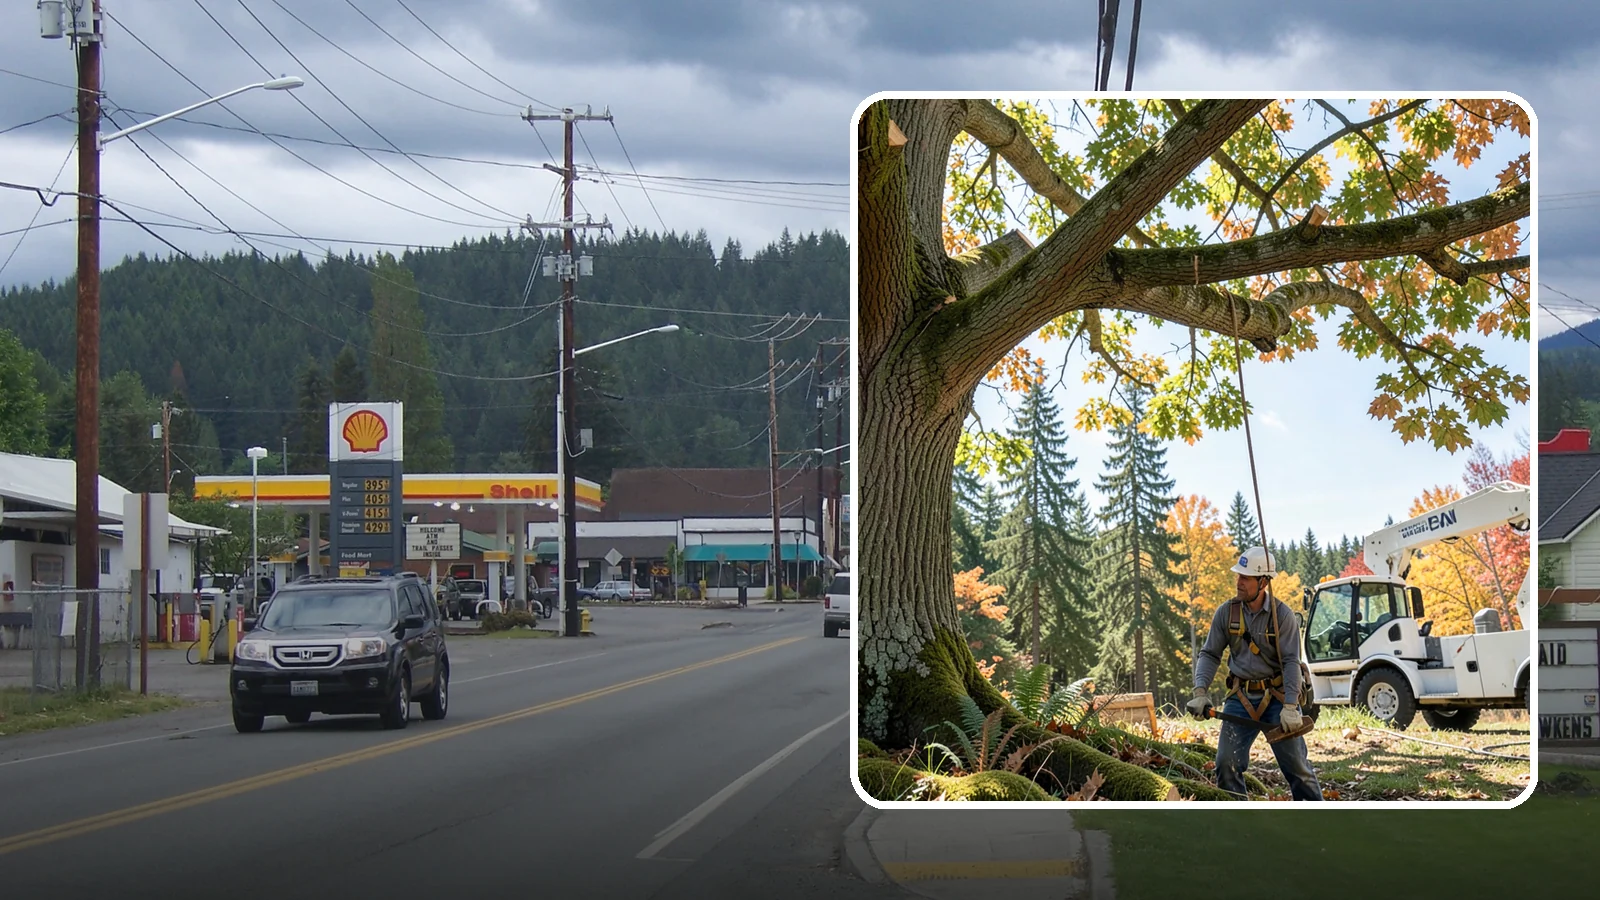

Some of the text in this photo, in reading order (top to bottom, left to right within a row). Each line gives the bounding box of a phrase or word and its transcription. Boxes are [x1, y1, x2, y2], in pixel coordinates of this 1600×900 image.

[365, 480, 383, 490] 395
[490, 484, 547, 499] Shell
[365, 494, 383, 504] 405
[365, 508, 383, 518] 415
[365, 522, 383, 532] 429
